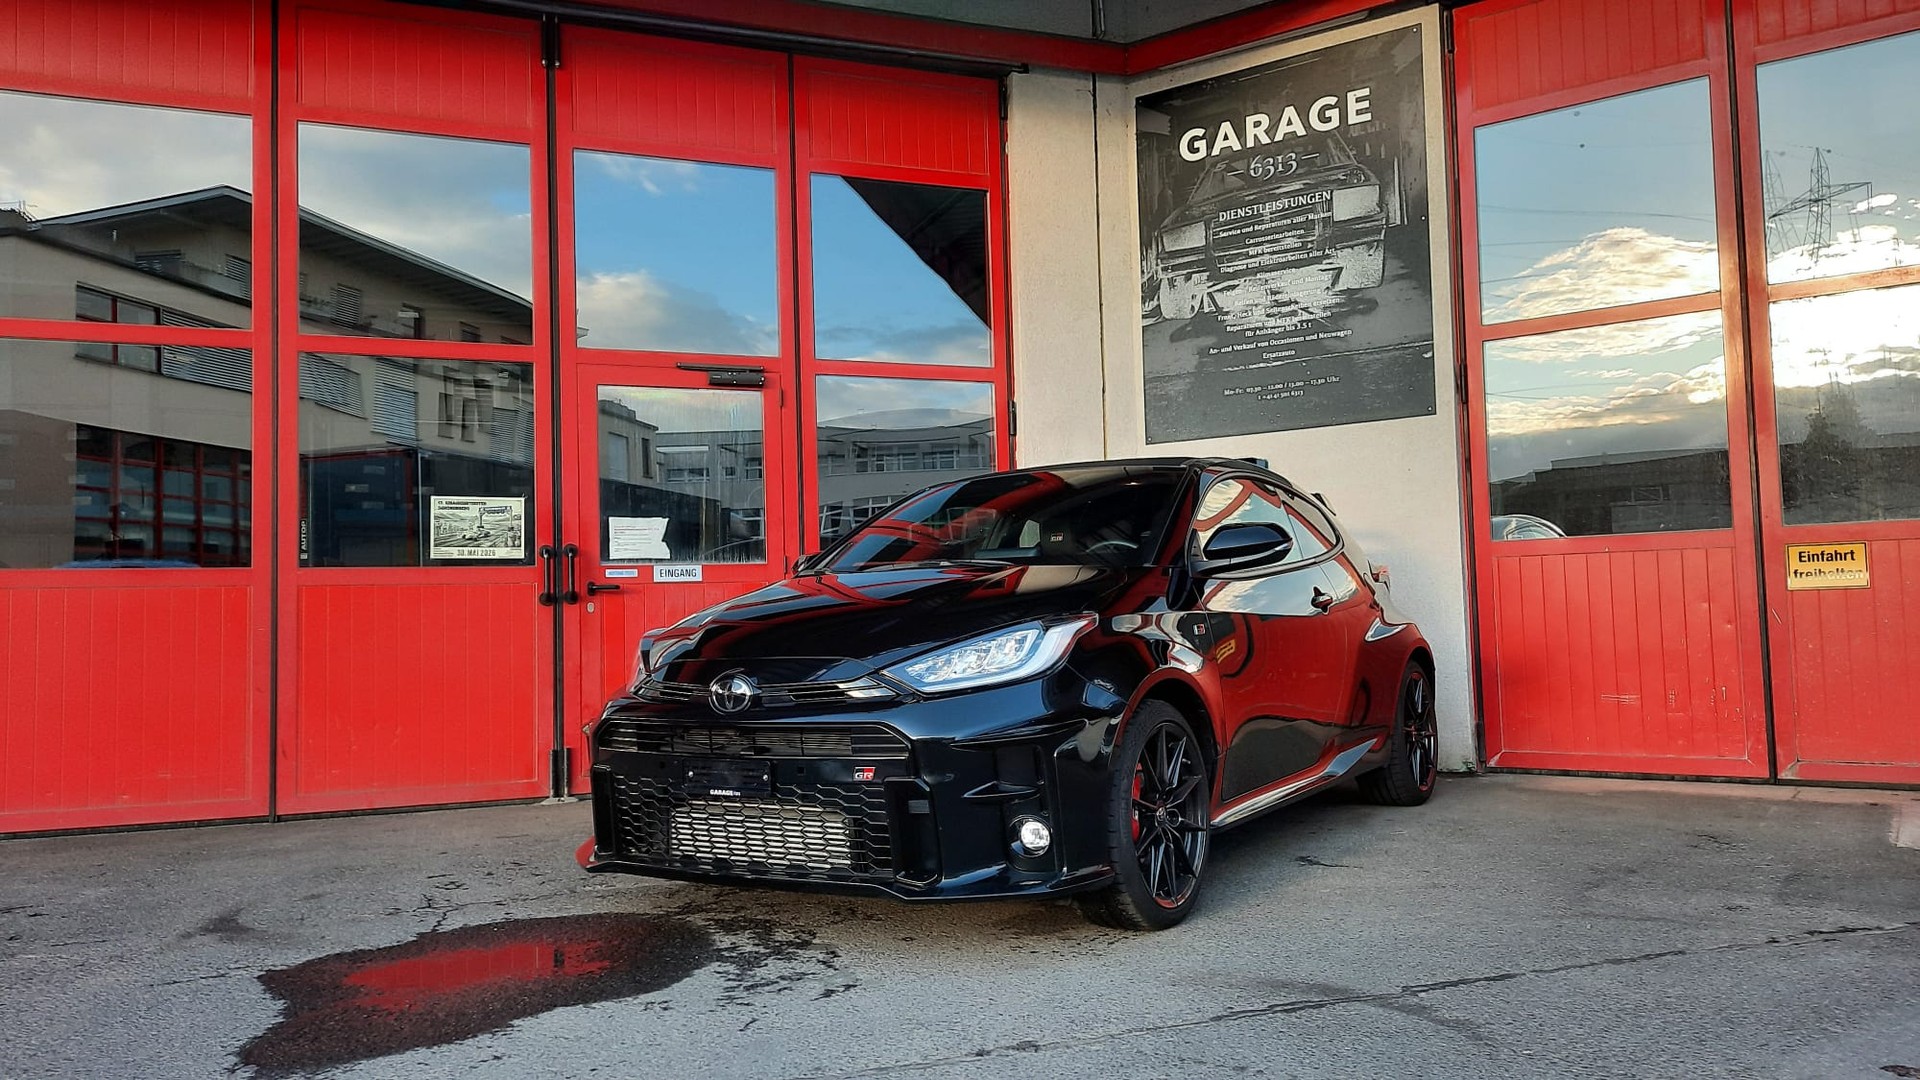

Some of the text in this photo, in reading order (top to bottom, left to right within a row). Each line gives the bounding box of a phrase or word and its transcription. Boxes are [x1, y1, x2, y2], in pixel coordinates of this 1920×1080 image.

[1179, 87, 1372, 162] GARAGE
[1250, 153, 1298, 180] 6313
[1219, 190, 1332, 221] DIENSTLEISTUNGEN
[1219, 229, 1240, 237] Service
[1241, 225, 1253, 233] und
[1254, 219, 1291, 231] Reparaturen
[1292, 214, 1307, 224] aller
[1245, 229, 1305, 244] Carrosseriearbeiten
[1263, 241, 1302, 253] bereitstellen
[1220, 246, 1336, 273] Diagnose und Elektroarbeiten aller Art
[1292, 276, 1304, 285] und
[1255, 325, 1284, 336] Anhänger
[1285, 322, 1296, 331] bis
[1220, 345, 1232, 353] und
[1233, 341, 1256, 351] Verkauf
[1305, 332, 1317, 341] und
[1318, 329, 1352, 339] Neuwagen
[1262, 350, 1296, 359] Ersatzauto
[1326, 375, 1340, 384] Uhr
[467, 549, 479, 557] MAI
[480, 549, 497, 557] 2026
[1798, 549, 1856, 563] Einfahrt
[659, 568, 697, 578] EINGANG
[855, 771, 874, 780] GR
